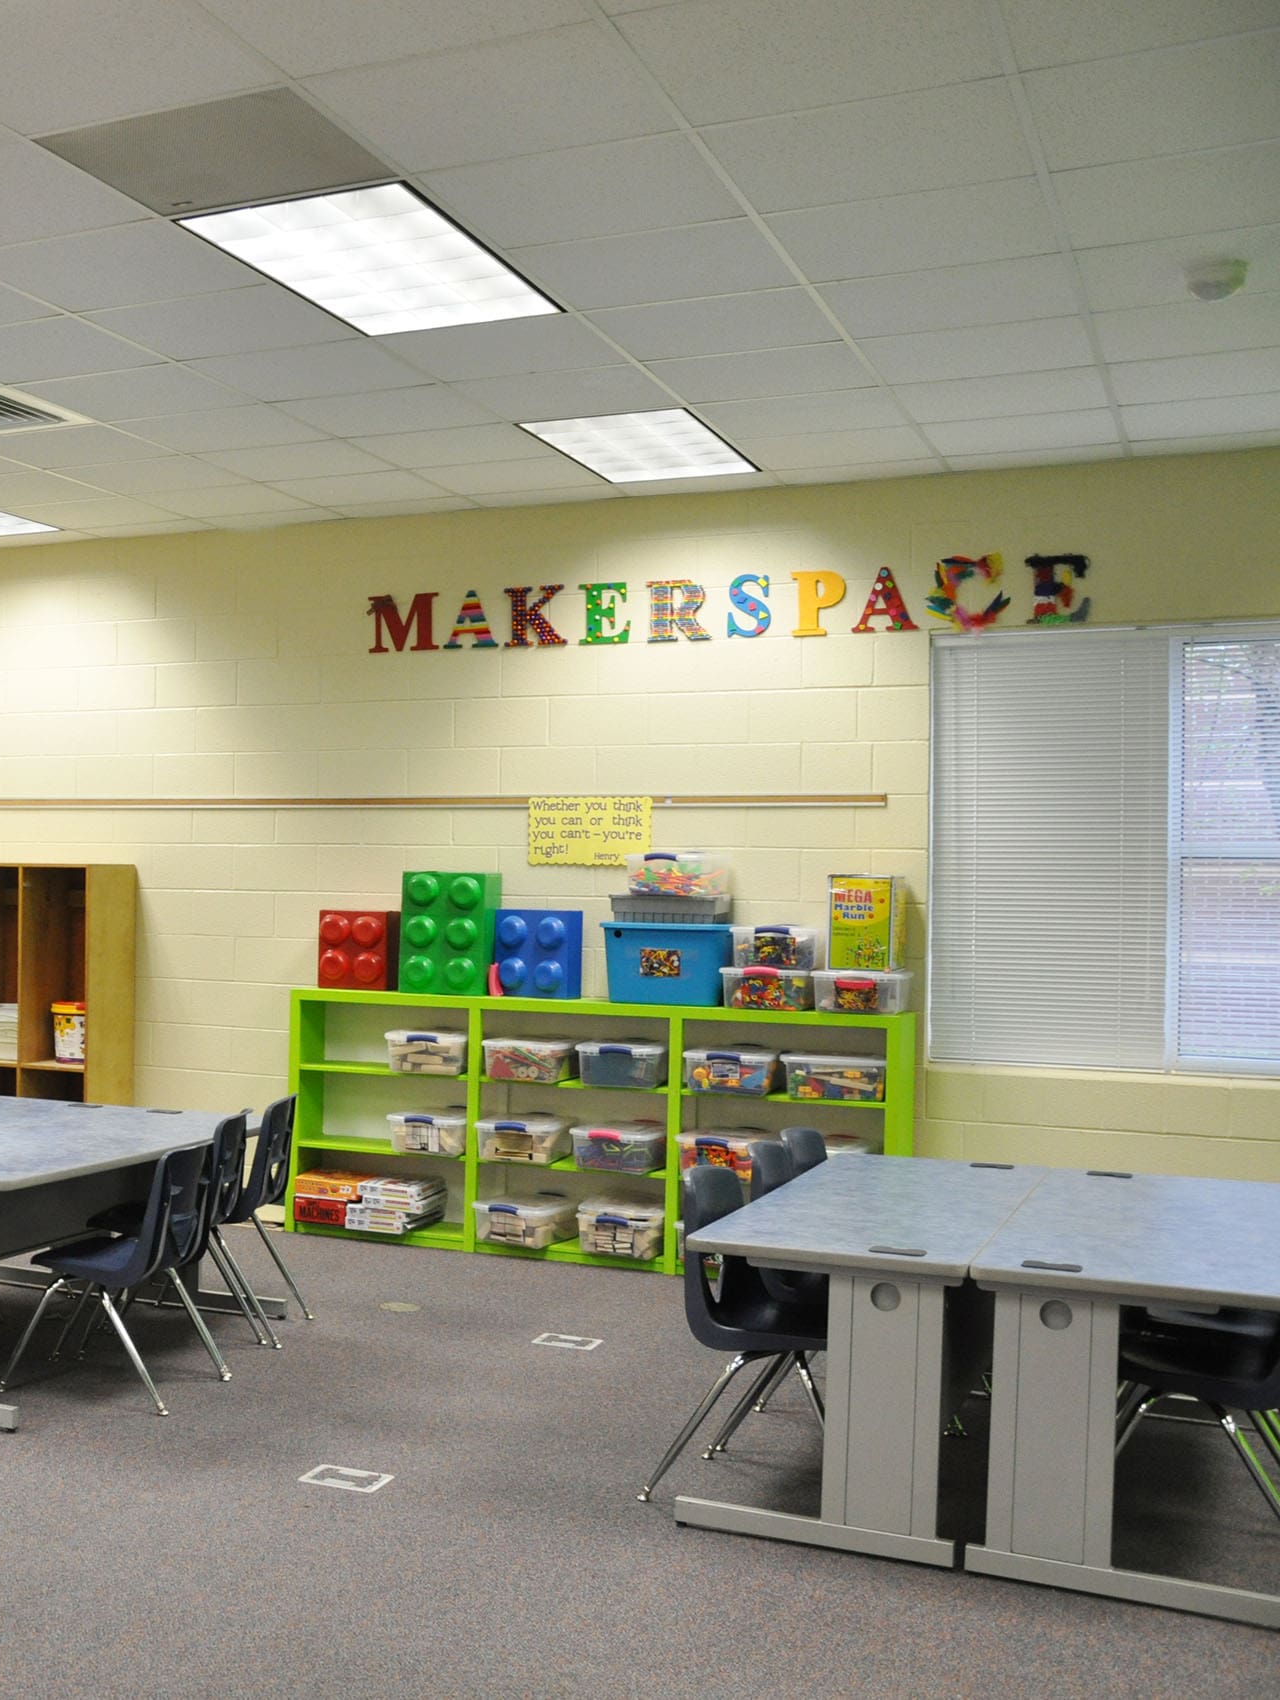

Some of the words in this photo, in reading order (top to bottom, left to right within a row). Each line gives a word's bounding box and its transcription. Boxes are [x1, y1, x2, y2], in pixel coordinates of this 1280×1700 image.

[531, 800, 581, 812] Whether
[585, 801, 608, 814] you
[613, 799, 643, 812] think
[534, 816, 557, 829] you
[561, 816, 583, 826] can
[589, 817, 604, 826] or
[612, 814, 643, 827] think
[532, 829, 555, 842] you
[533, 842, 569, 858] right!
[593, 852, 620, 863] Henry
[834, 889, 873, 904] MEGA
[834, 903, 874, 912] Marble
[842, 911, 866, 920] Run
[299, 1204, 340, 1222] MACHINES
